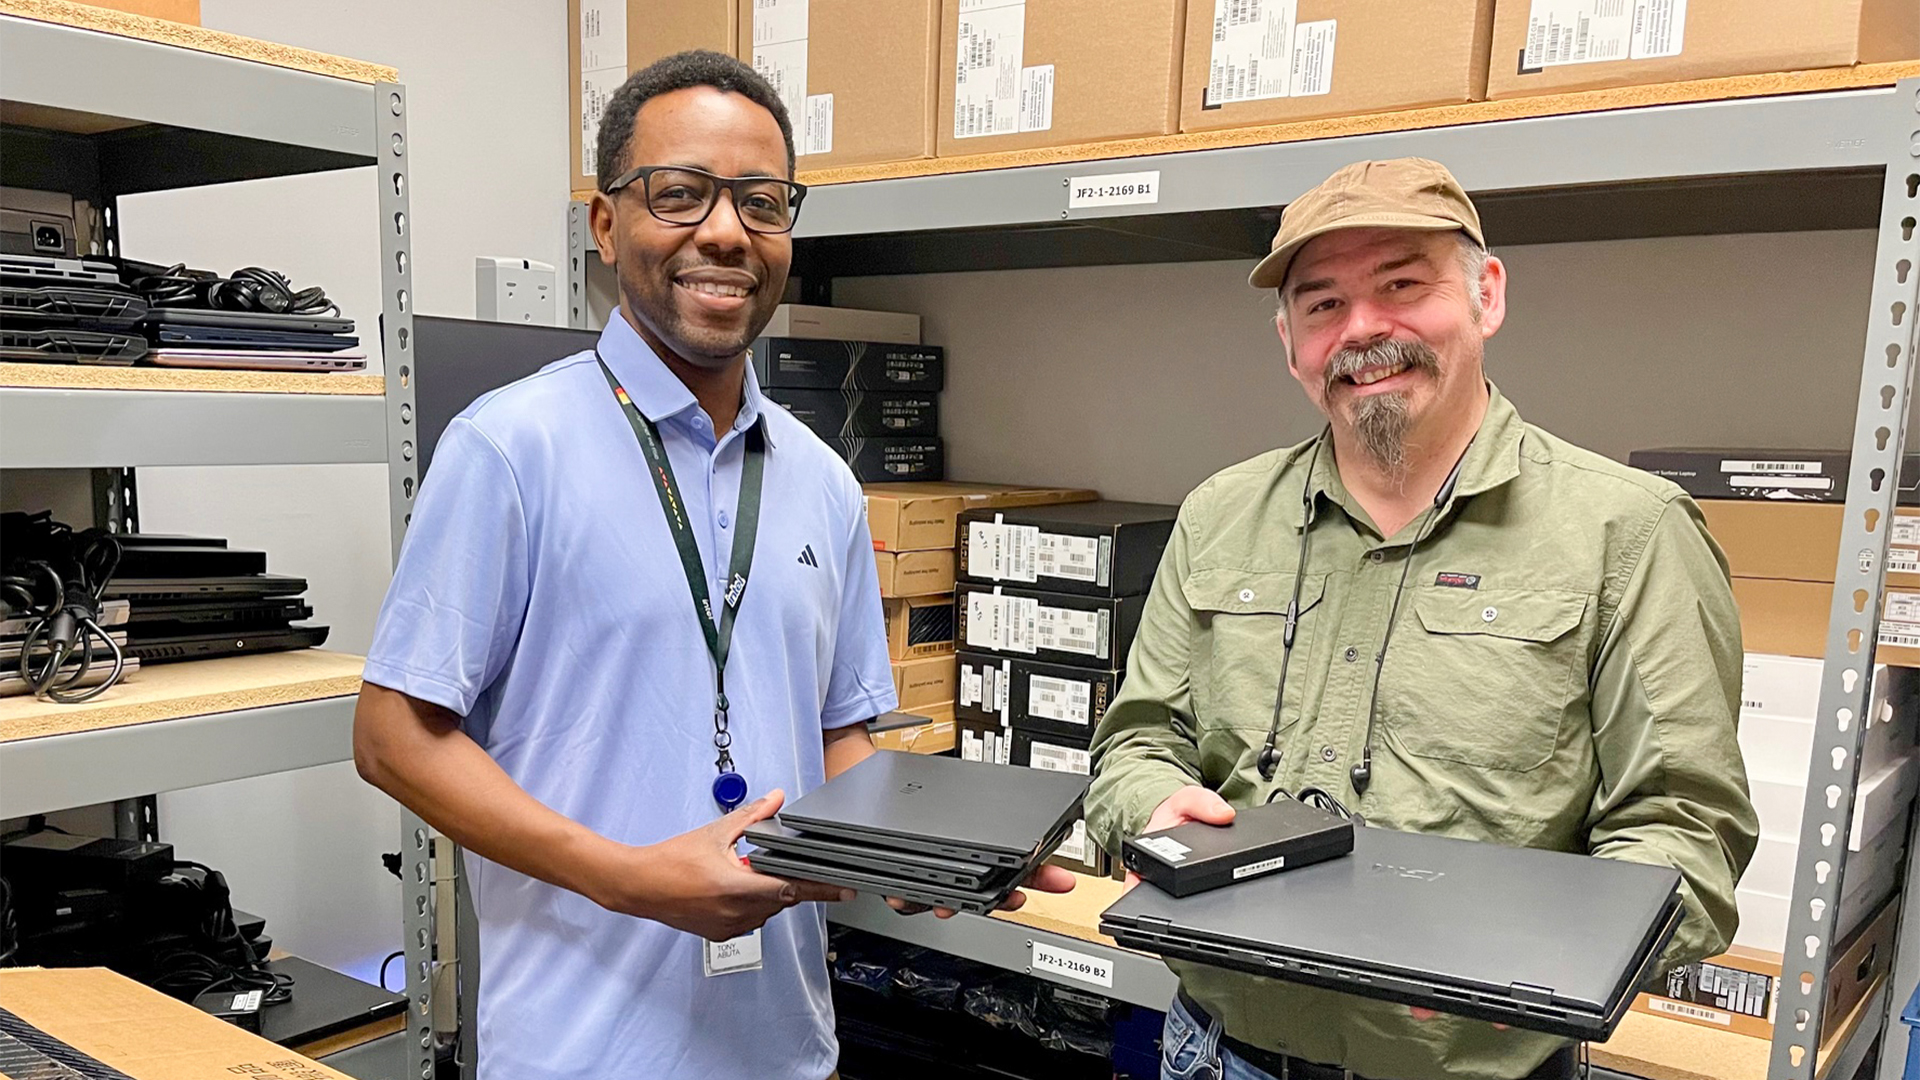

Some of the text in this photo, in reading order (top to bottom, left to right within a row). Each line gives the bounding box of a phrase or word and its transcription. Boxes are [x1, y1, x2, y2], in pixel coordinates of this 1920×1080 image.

[1635, 5, 1644, 34] Warning
[1076, 184, 1151, 198] JF2-1-2169 B1
[726, 574, 746, 607] intel
[702, 598, 714, 620] intel
[717, 942, 736, 952] TONY
[717, 949, 740, 959] ABUTA
[1038, 953, 1106, 978] JF2-1-2169 B2
